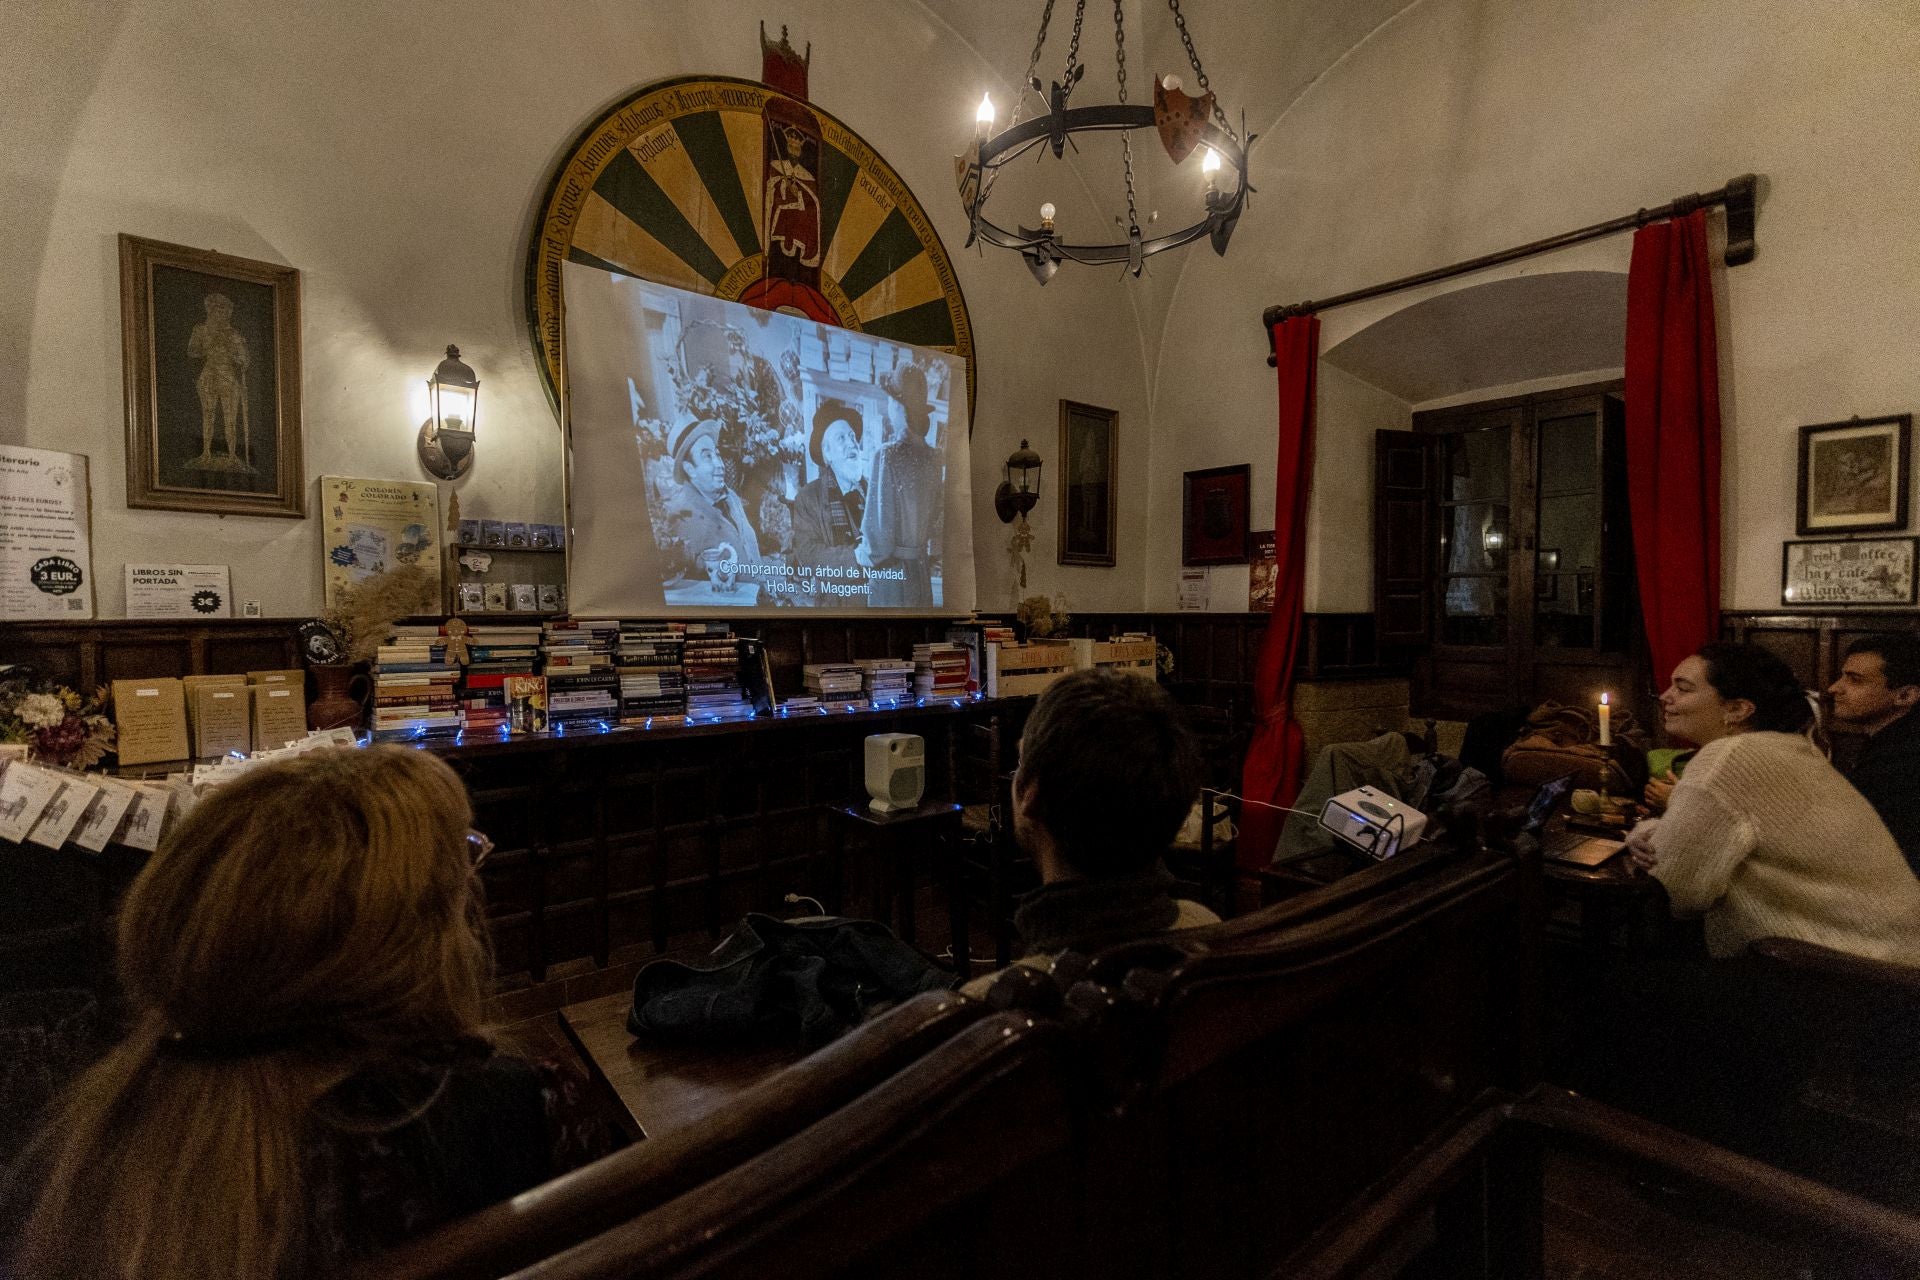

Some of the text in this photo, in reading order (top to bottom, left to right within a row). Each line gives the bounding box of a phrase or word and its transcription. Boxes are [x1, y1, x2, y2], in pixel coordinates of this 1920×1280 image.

[360, 492, 407, 500] COLORADO
[34, 559, 80, 574] CADA LIBRO
[132, 568, 166, 576] LIBROS
[168, 568, 183, 576] SIN
[719, 560, 907, 580] Comprando un árbol de Navidad.
[40, 571, 77, 581] 3 EUR.
[767, 579, 873, 597] Hola, Sr. Maggenti.
[198, 597, 214, 606] 3€
[515, 681, 544, 693] KING
